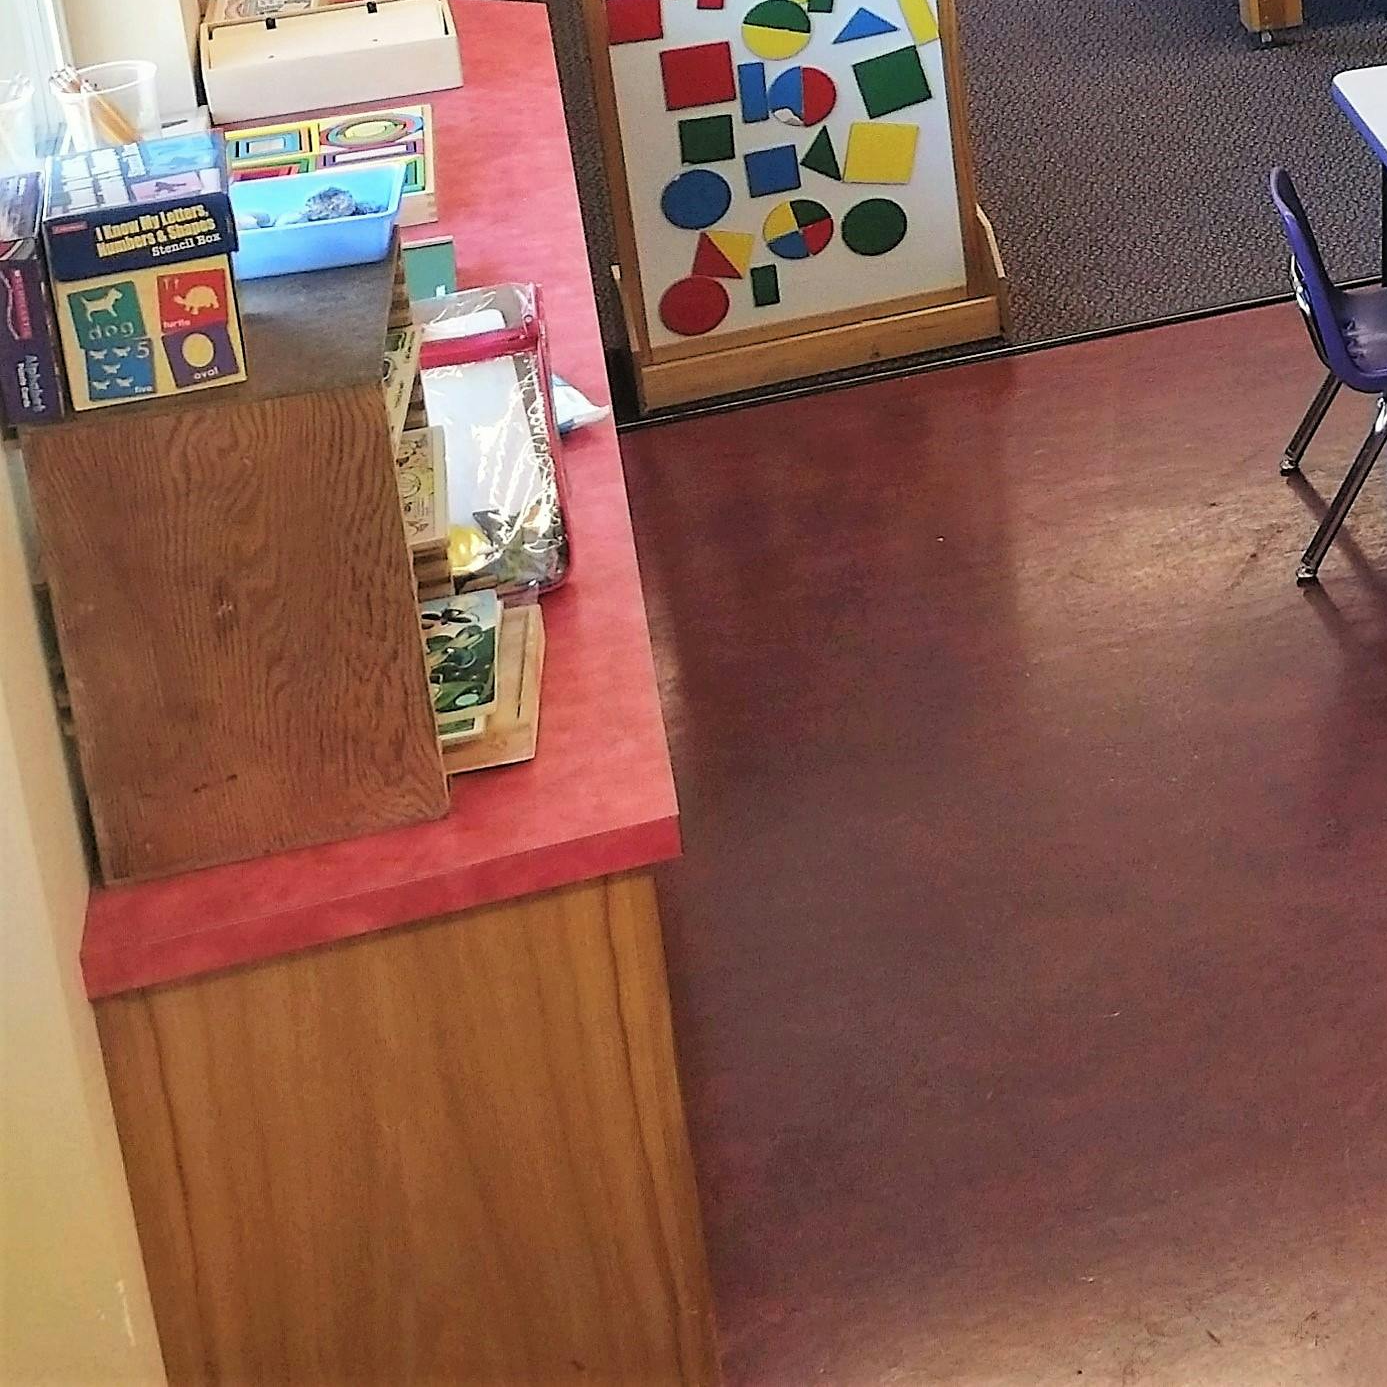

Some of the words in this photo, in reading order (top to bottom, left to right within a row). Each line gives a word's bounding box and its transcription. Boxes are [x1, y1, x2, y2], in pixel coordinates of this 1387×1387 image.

[95, 226, 103, 241] I
[103, 215, 140, 240] Know
[140, 213, 159, 231] My
[159, 204, 209, 227] Letters,
[96, 233, 155, 258] Numbers
[156, 228, 166, 243] &
[167, 218, 216, 239] Shapes
[151, 237, 195, 257] Stencil
[197, 231, 222, 246] Box
[89, 321, 135, 341] dog
[163, 319, 191, 329] turtle
[136, 341, 150, 359] 5
[193, 367, 219, 380] oval
[135, 385, 153, 394] five
